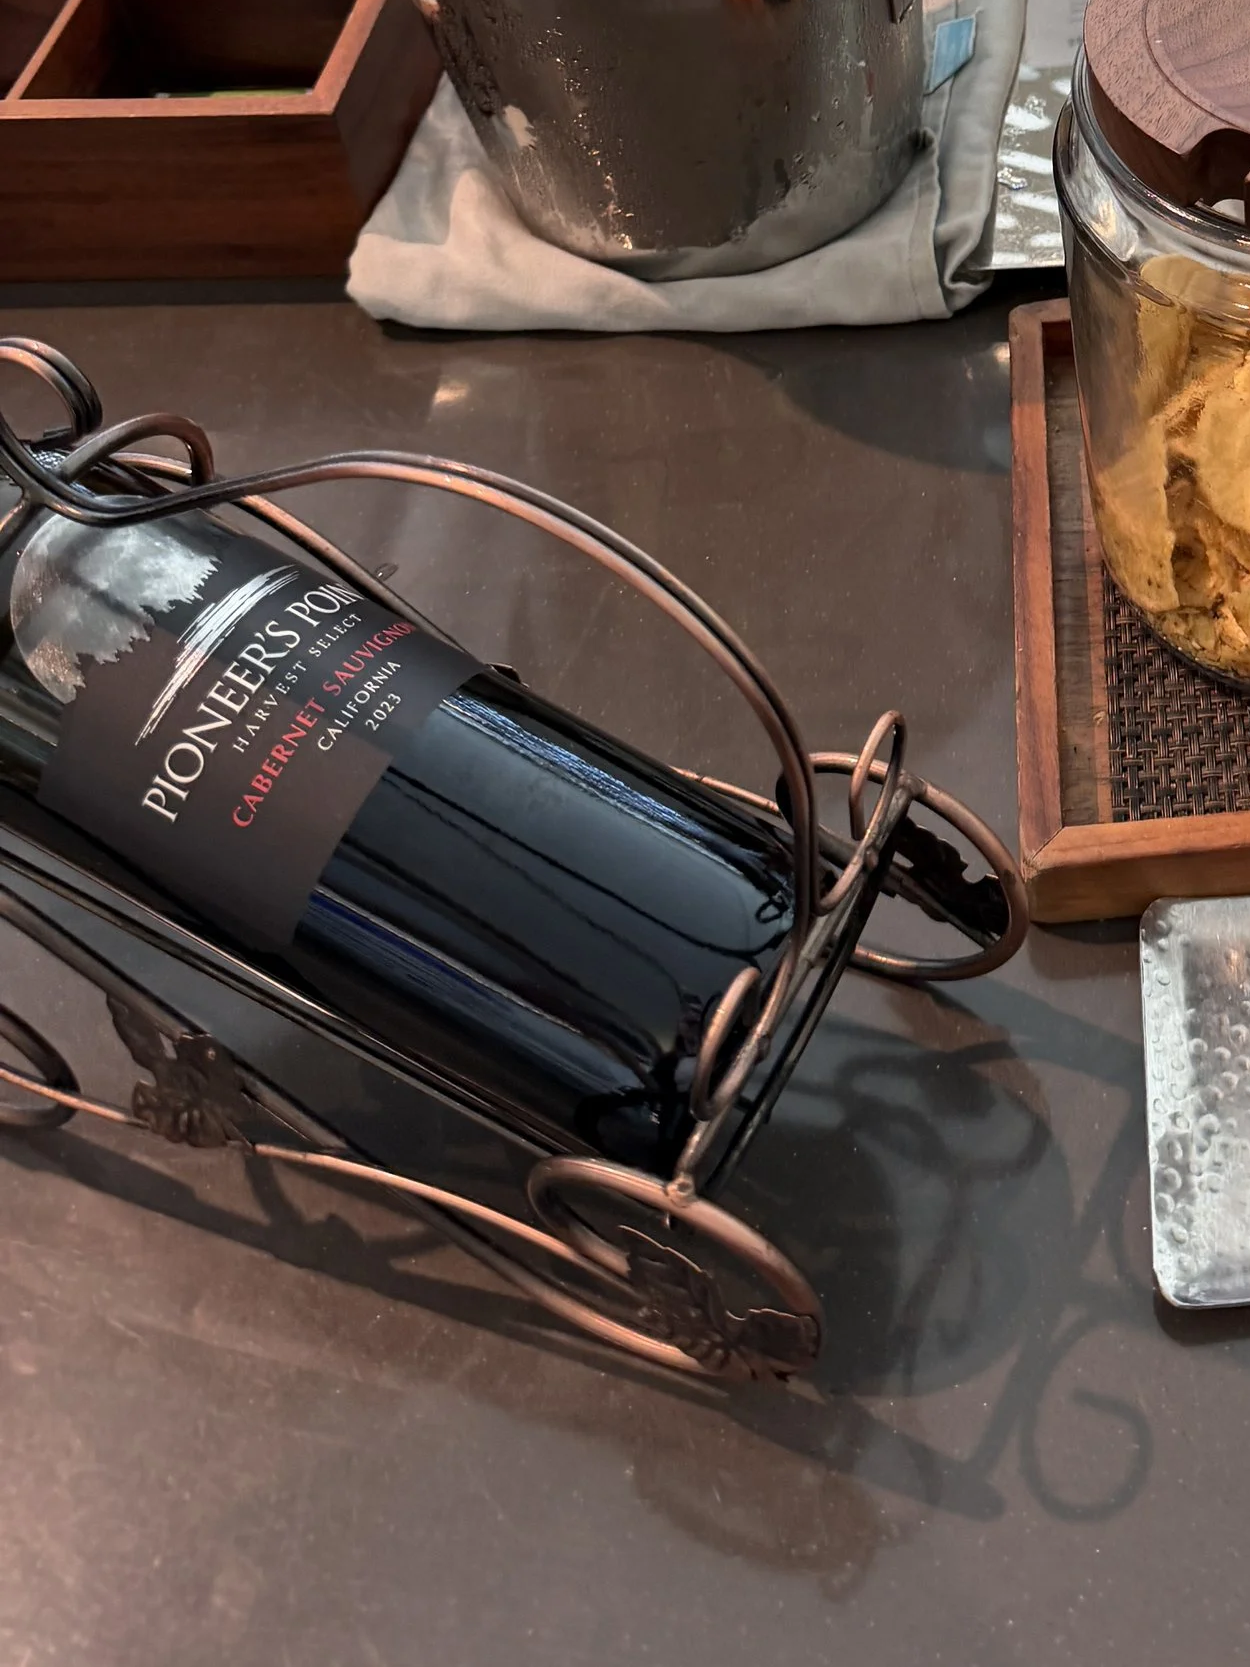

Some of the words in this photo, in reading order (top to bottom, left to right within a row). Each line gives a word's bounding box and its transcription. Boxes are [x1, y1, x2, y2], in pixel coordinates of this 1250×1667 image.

[141, 620, 301, 825] PIONEER'S
[285, 582, 365, 628] POIN
[232, 659, 309, 754] HARVEST
[308, 612, 363, 659] SELECT
[316, 660, 402, 753] CALIFORNIA
[365, 692, 402, 732] 2023
[231, 696, 326, 829] CABERNET
